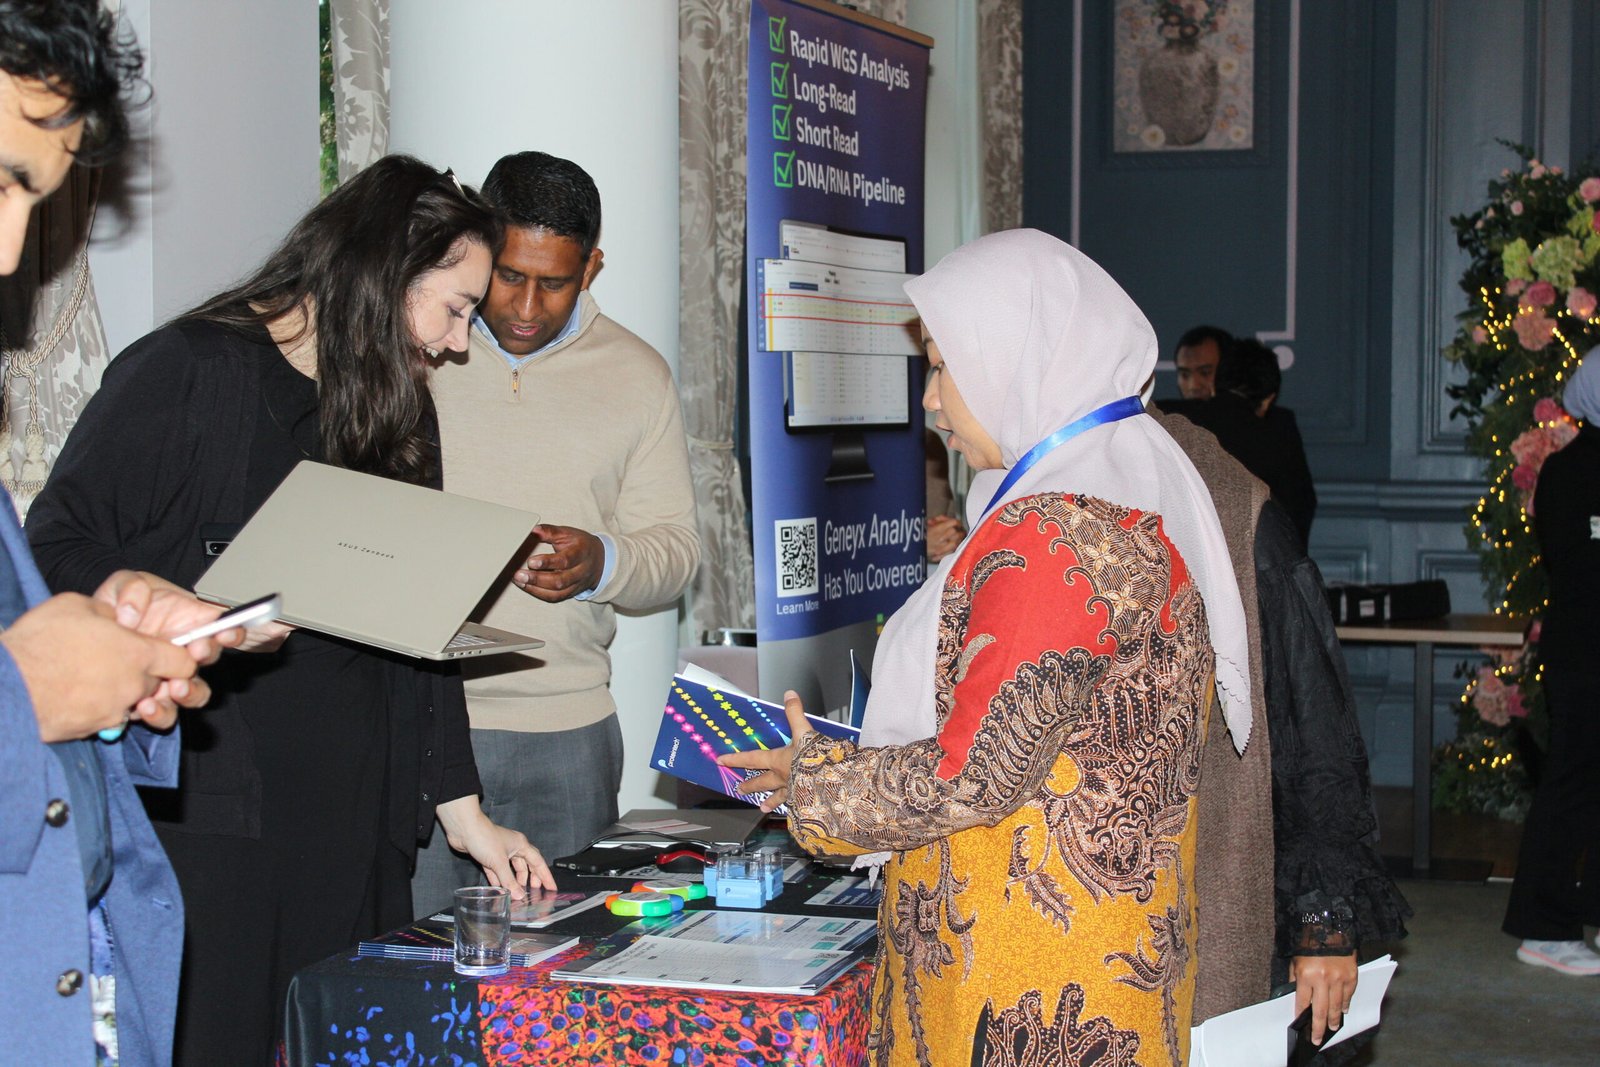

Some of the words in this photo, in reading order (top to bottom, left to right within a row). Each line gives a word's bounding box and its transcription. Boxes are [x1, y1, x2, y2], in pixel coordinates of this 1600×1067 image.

[790, 30, 828, 68] Rapid
[830, 42, 858, 75] WGS
[860, 53, 910, 91] Analysis
[793, 73, 856, 116] Long-Read
[796, 117, 831, 149] Short
[833, 125, 859, 157] Read
[797, 159, 851, 196] DNA/RNA
[853, 173, 905, 206] Pipeline
[824, 520, 866, 560] Geneyx
[824, 572, 842, 601] Has
[844, 569, 864, 596] You
[776, 602, 804, 615] Learn
[805, 600, 819, 612] More
